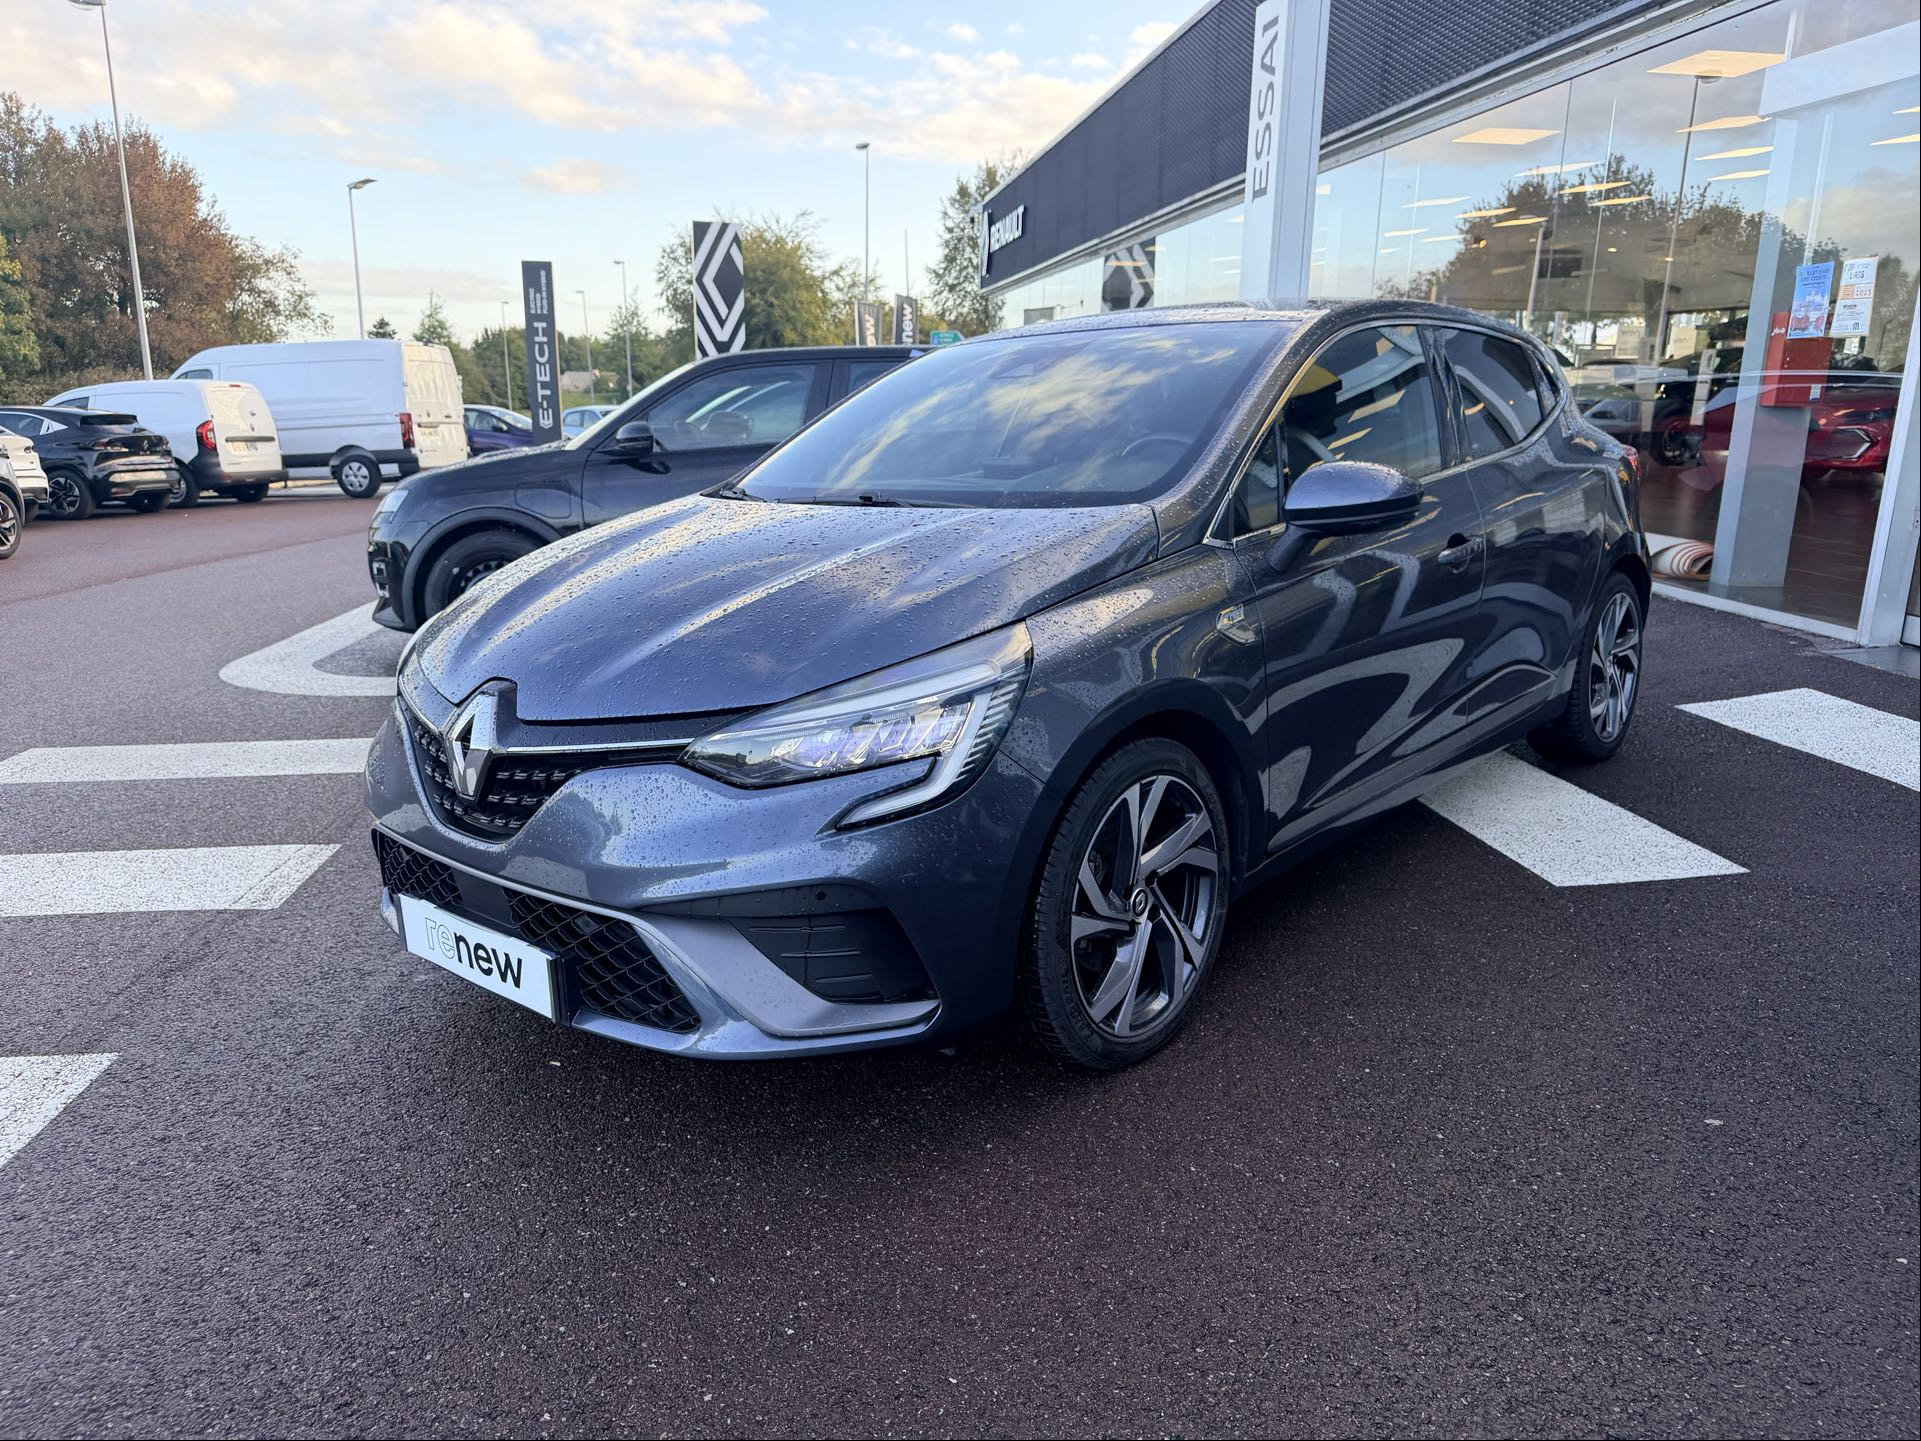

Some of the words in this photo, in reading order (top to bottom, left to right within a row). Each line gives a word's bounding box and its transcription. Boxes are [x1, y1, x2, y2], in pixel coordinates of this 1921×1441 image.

[1252, 15, 1280, 203] ESSAI
[990, 204, 1025, 254] RENAULT
[1855, 288, 1872, 297] 2025
[533, 321, 554, 429] E-TECH
[425, 917, 523, 990] renew
